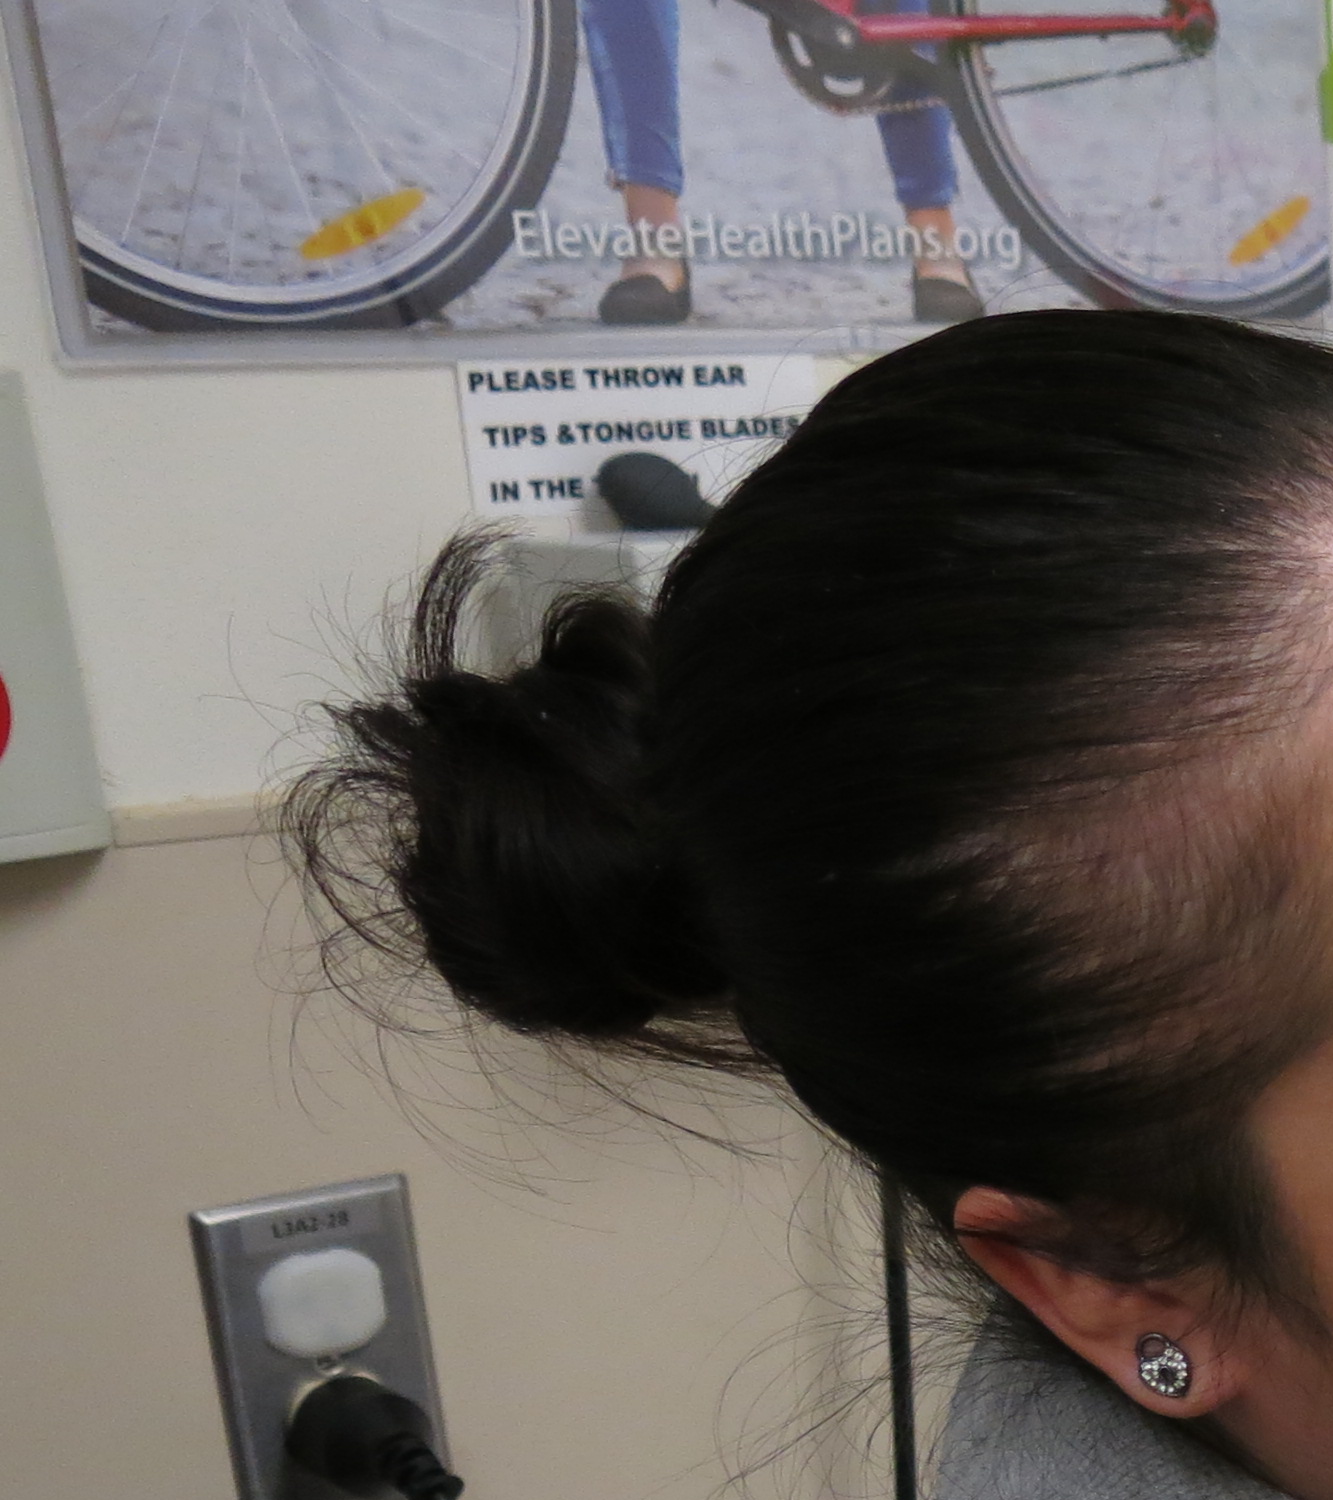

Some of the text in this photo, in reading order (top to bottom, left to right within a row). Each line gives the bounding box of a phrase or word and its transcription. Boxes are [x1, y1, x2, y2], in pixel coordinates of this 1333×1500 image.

[511, 208, 1023, 271] ElevateHealthPlans.org
[468, 365, 746, 393] PLEASE THROW EAR
[483, 425, 546, 447] TIPS
[490, 480, 520, 502] IN
[528, 477, 585, 500] THE
